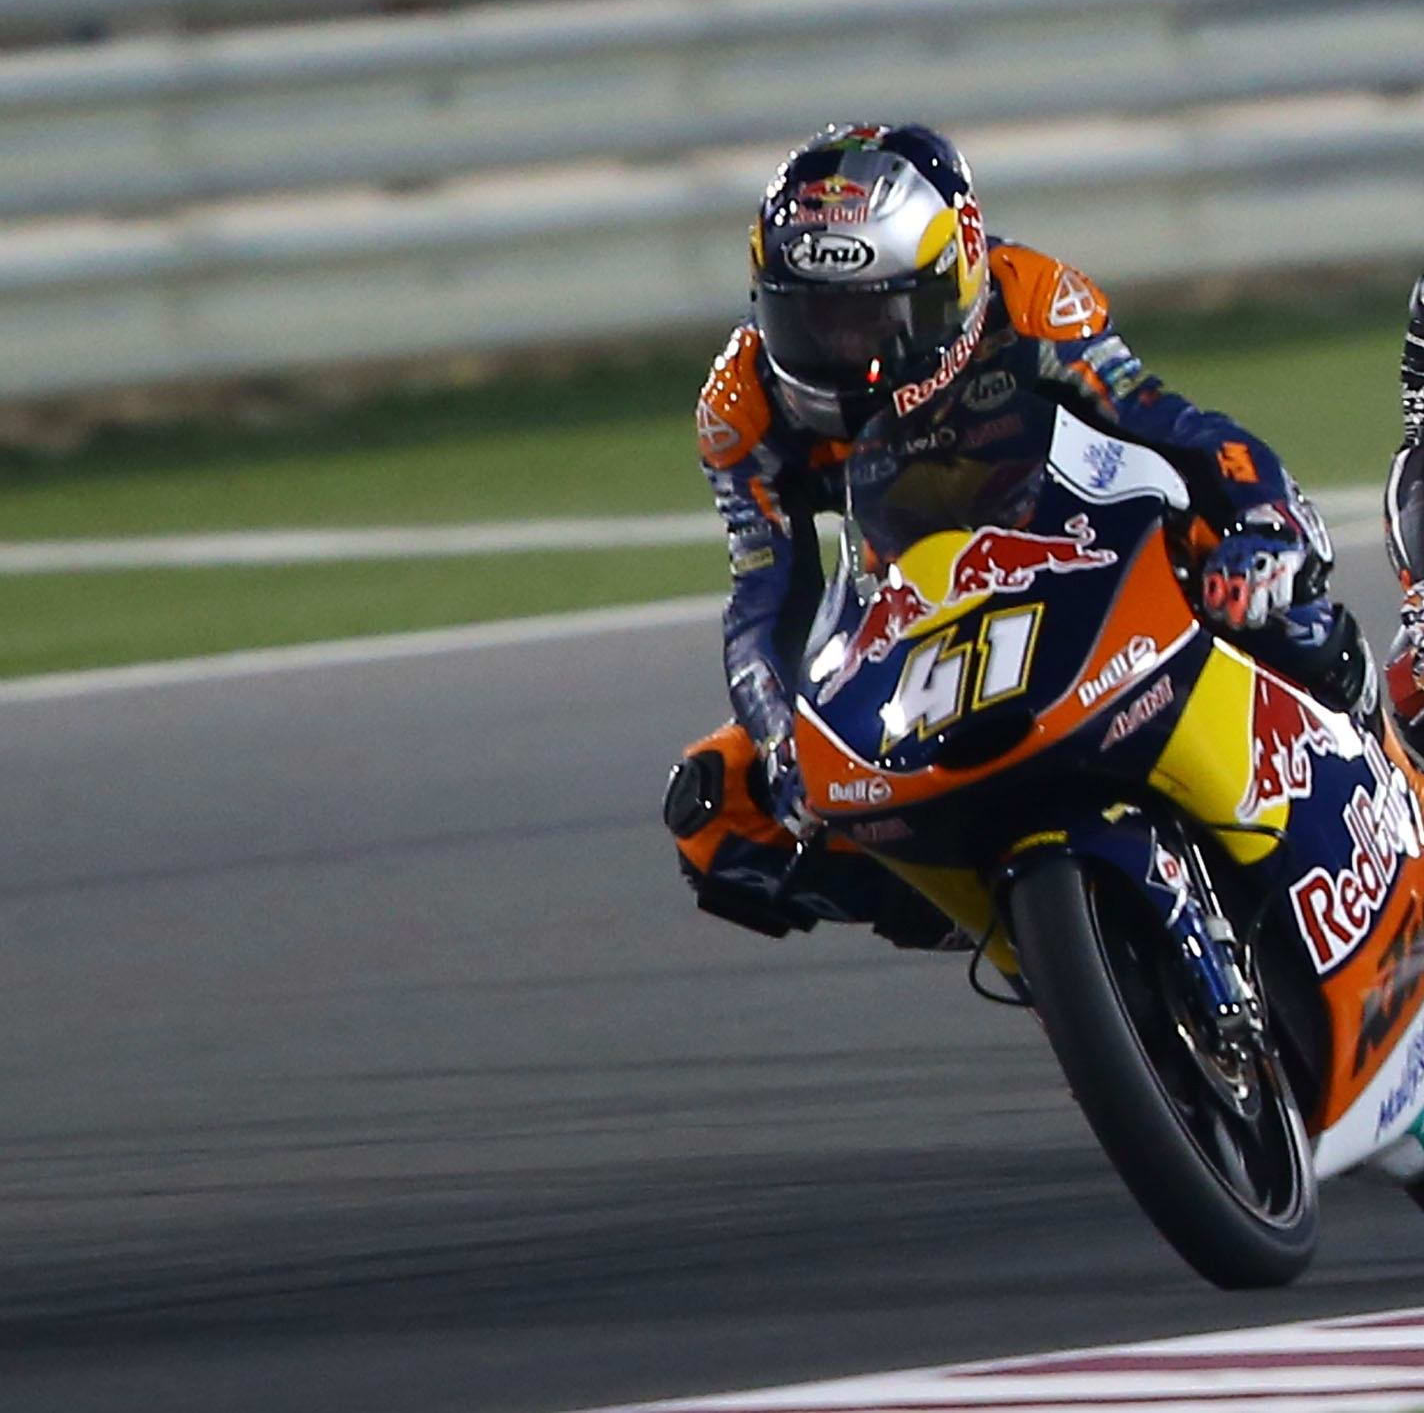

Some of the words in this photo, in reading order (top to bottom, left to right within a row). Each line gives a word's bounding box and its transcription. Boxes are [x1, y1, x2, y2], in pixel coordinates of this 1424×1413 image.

[829, 204, 868, 224] Bull
[802, 237, 861, 266] Arai
[895, 355, 953, 416] Red
[880, 602, 1044, 755] 41
